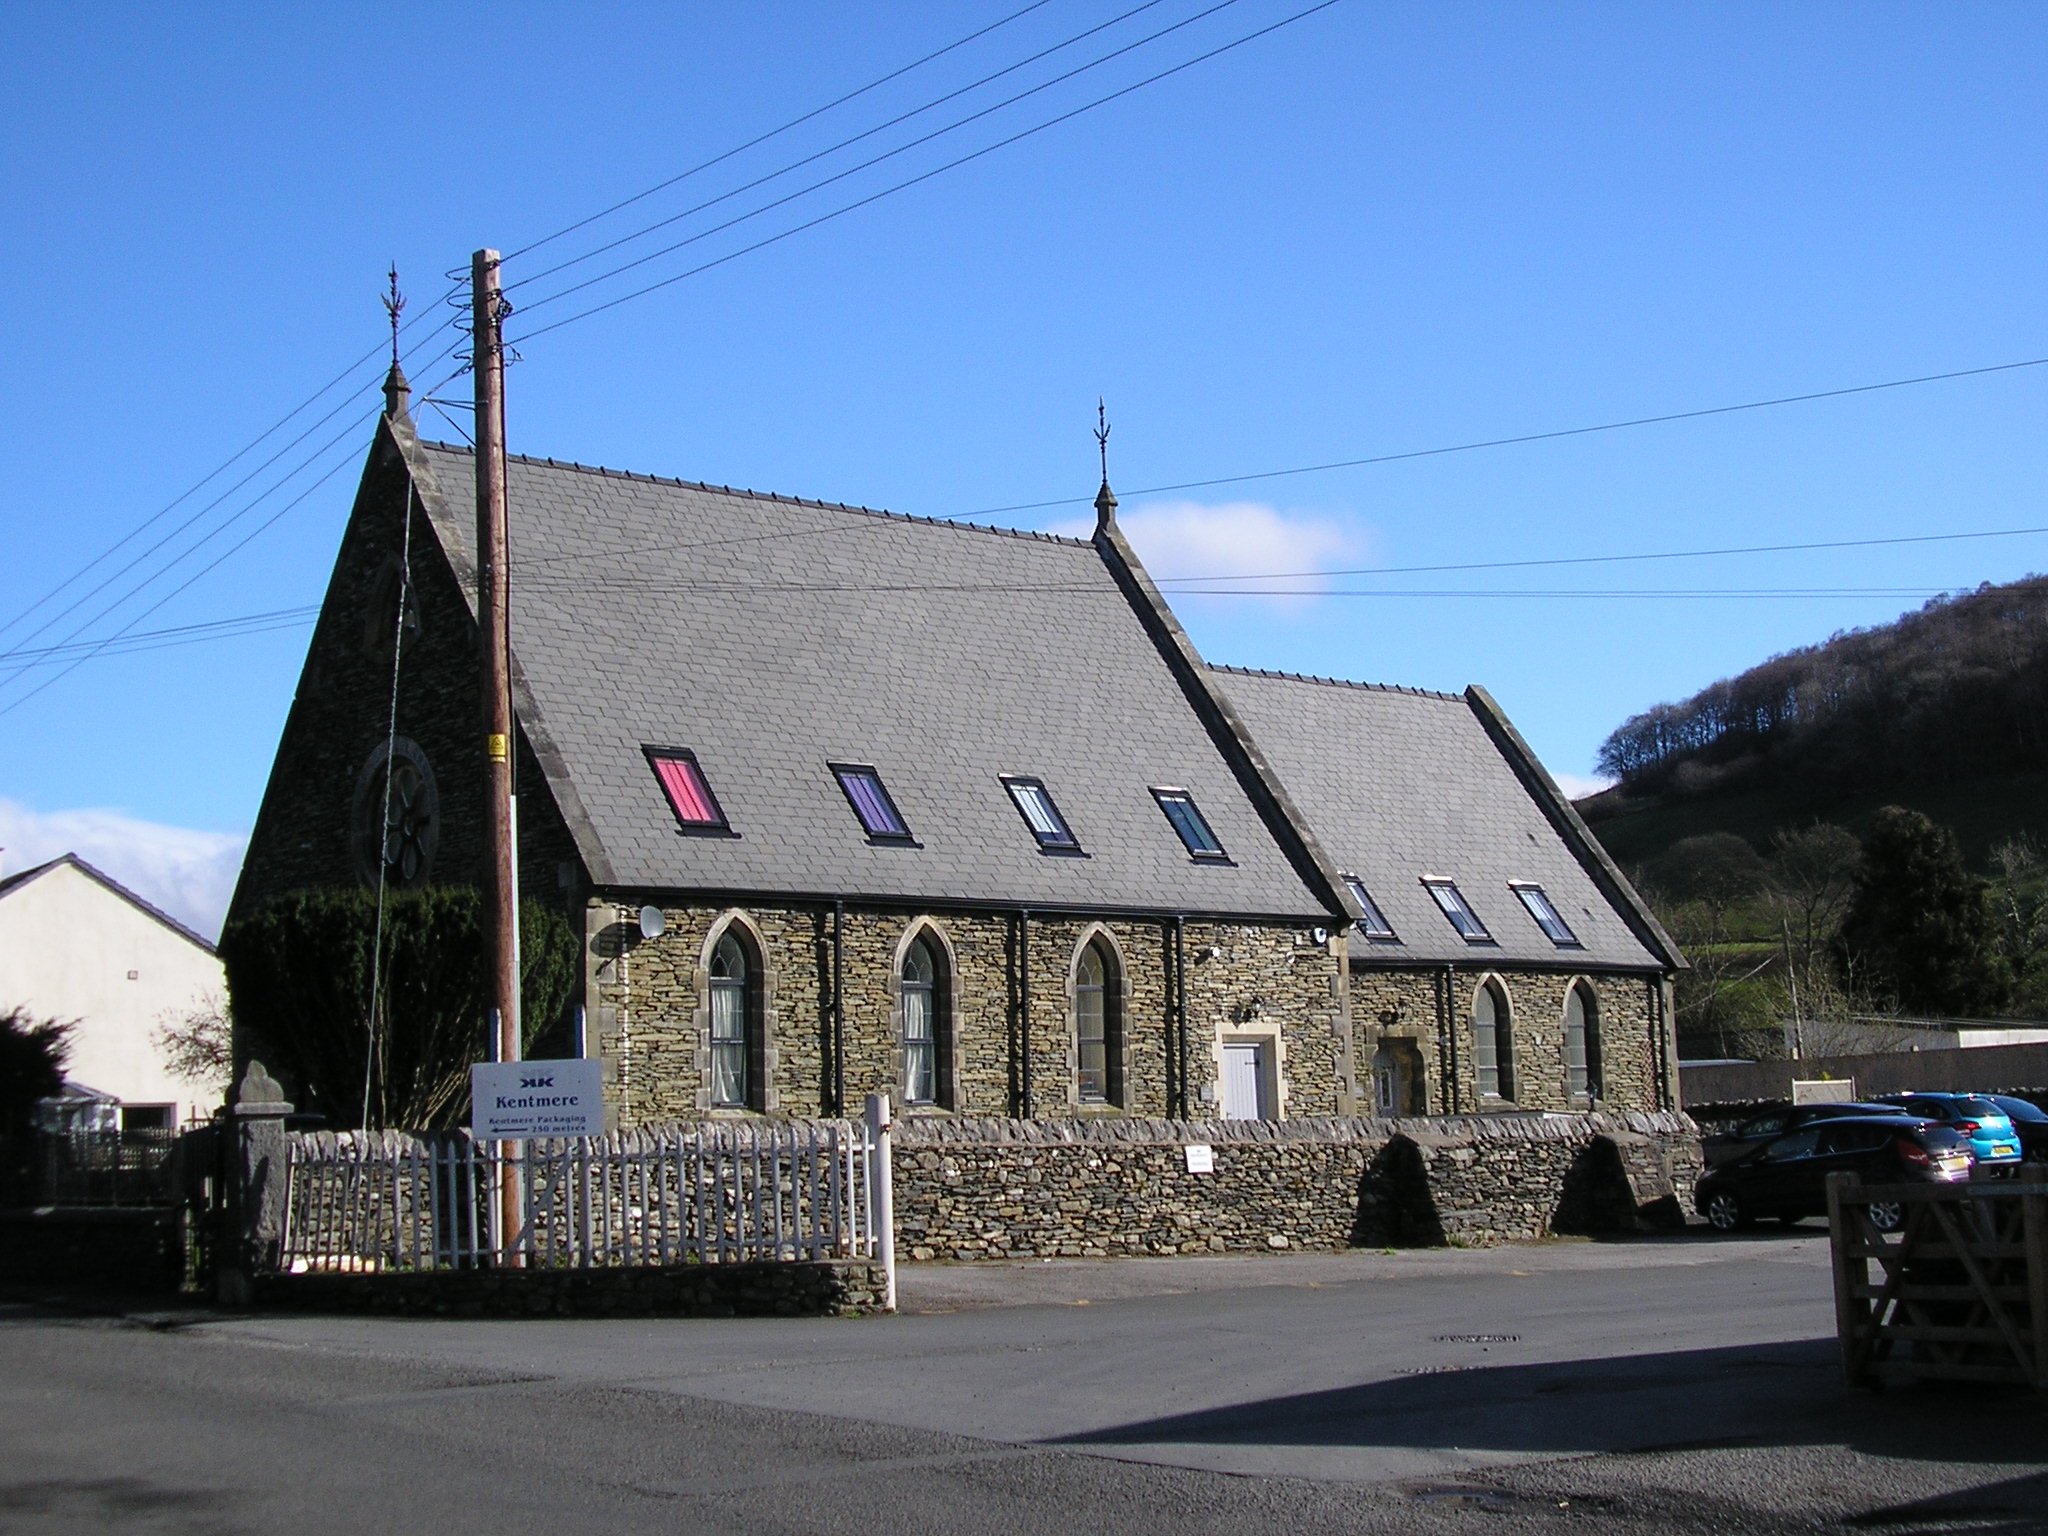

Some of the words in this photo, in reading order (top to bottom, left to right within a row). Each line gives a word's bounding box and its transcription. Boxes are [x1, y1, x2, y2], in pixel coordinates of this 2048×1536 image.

[496, 1096, 578, 1109] Kentmere
[537, 1115, 586, 1123] Packaging
[552, 1125, 586, 1133] metres
